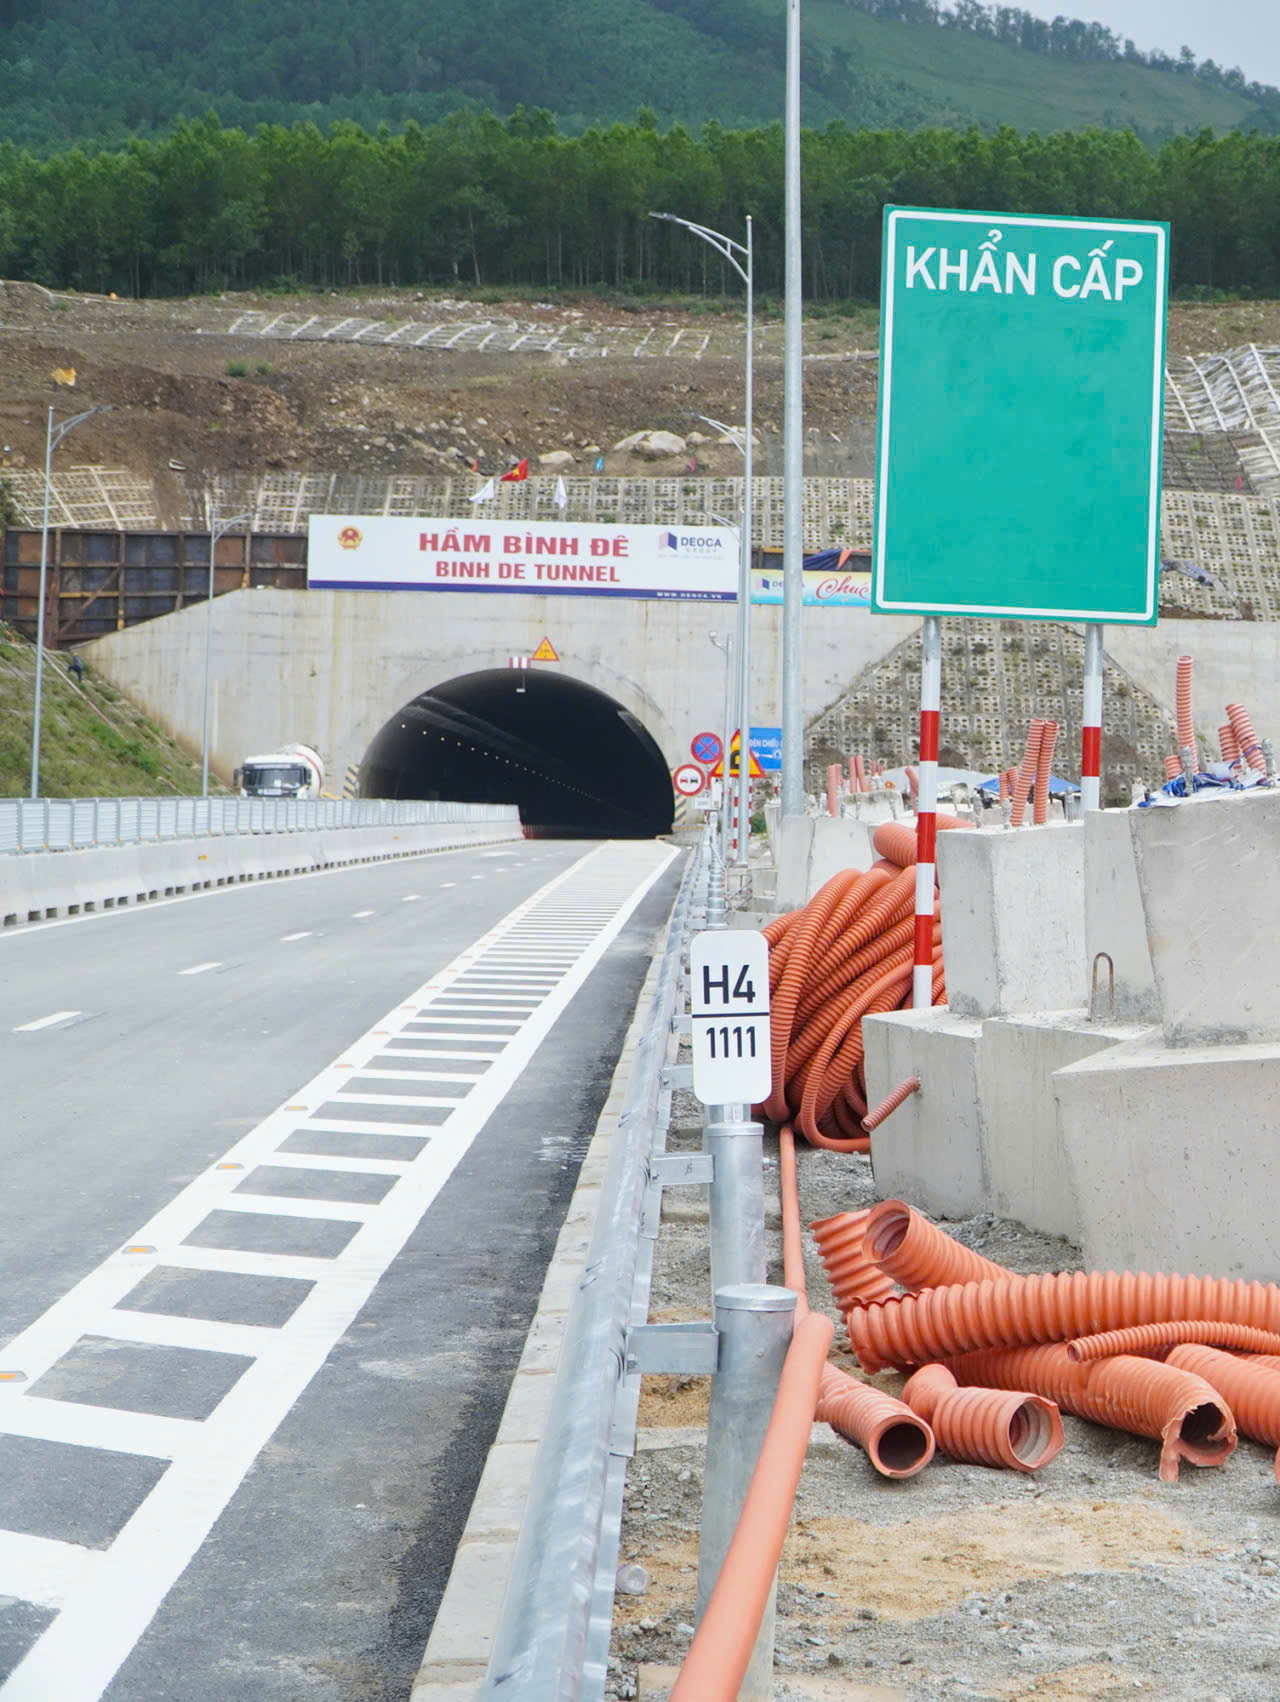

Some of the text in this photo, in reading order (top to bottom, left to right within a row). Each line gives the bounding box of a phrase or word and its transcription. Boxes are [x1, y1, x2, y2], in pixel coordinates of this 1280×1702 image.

[905, 229, 1144, 301] KHẨN CẤP
[419, 526, 629, 558] HẦM BÌNH ĐÊ
[680, 537, 722, 548] DEOCA
[436, 561, 620, 582] BINH DE TUNNEL
[703, 964, 756, 1005] H4
[706, 1026, 756, 1059] 1111
